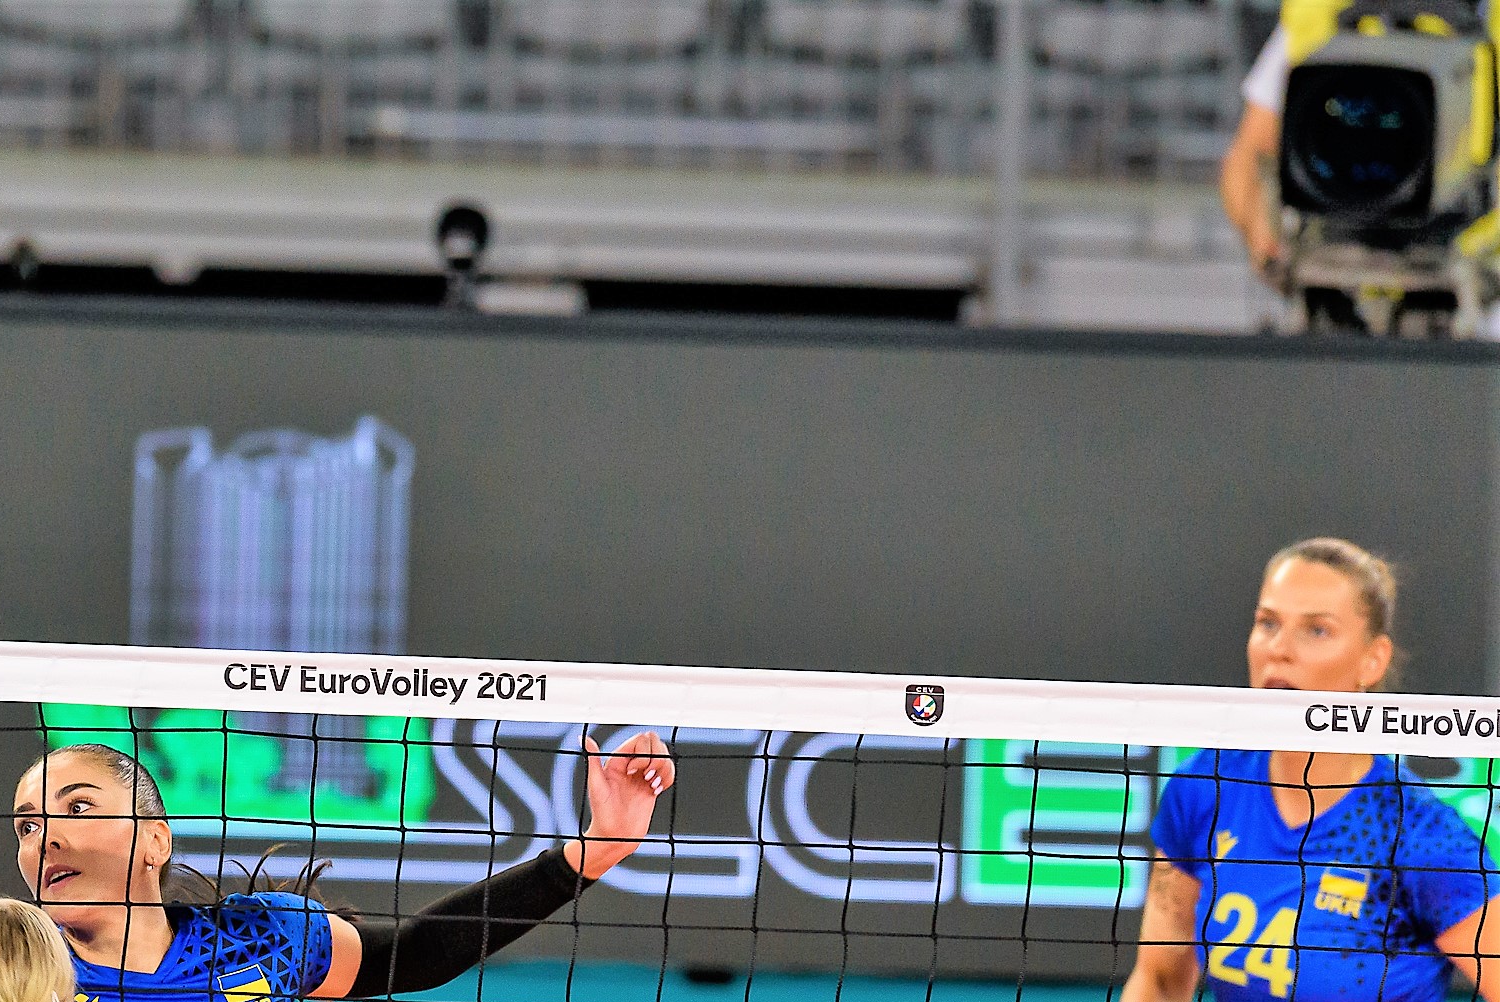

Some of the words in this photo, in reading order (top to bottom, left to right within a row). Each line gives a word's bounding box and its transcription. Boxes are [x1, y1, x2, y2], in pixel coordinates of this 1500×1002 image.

[224, 663, 291, 692] CEV
[299, 665, 468, 706] EuroVolley
[477, 672, 547, 701] 2021
[1305, 704, 1374, 733] CEV
[1208, 892, 1298, 998] 24
